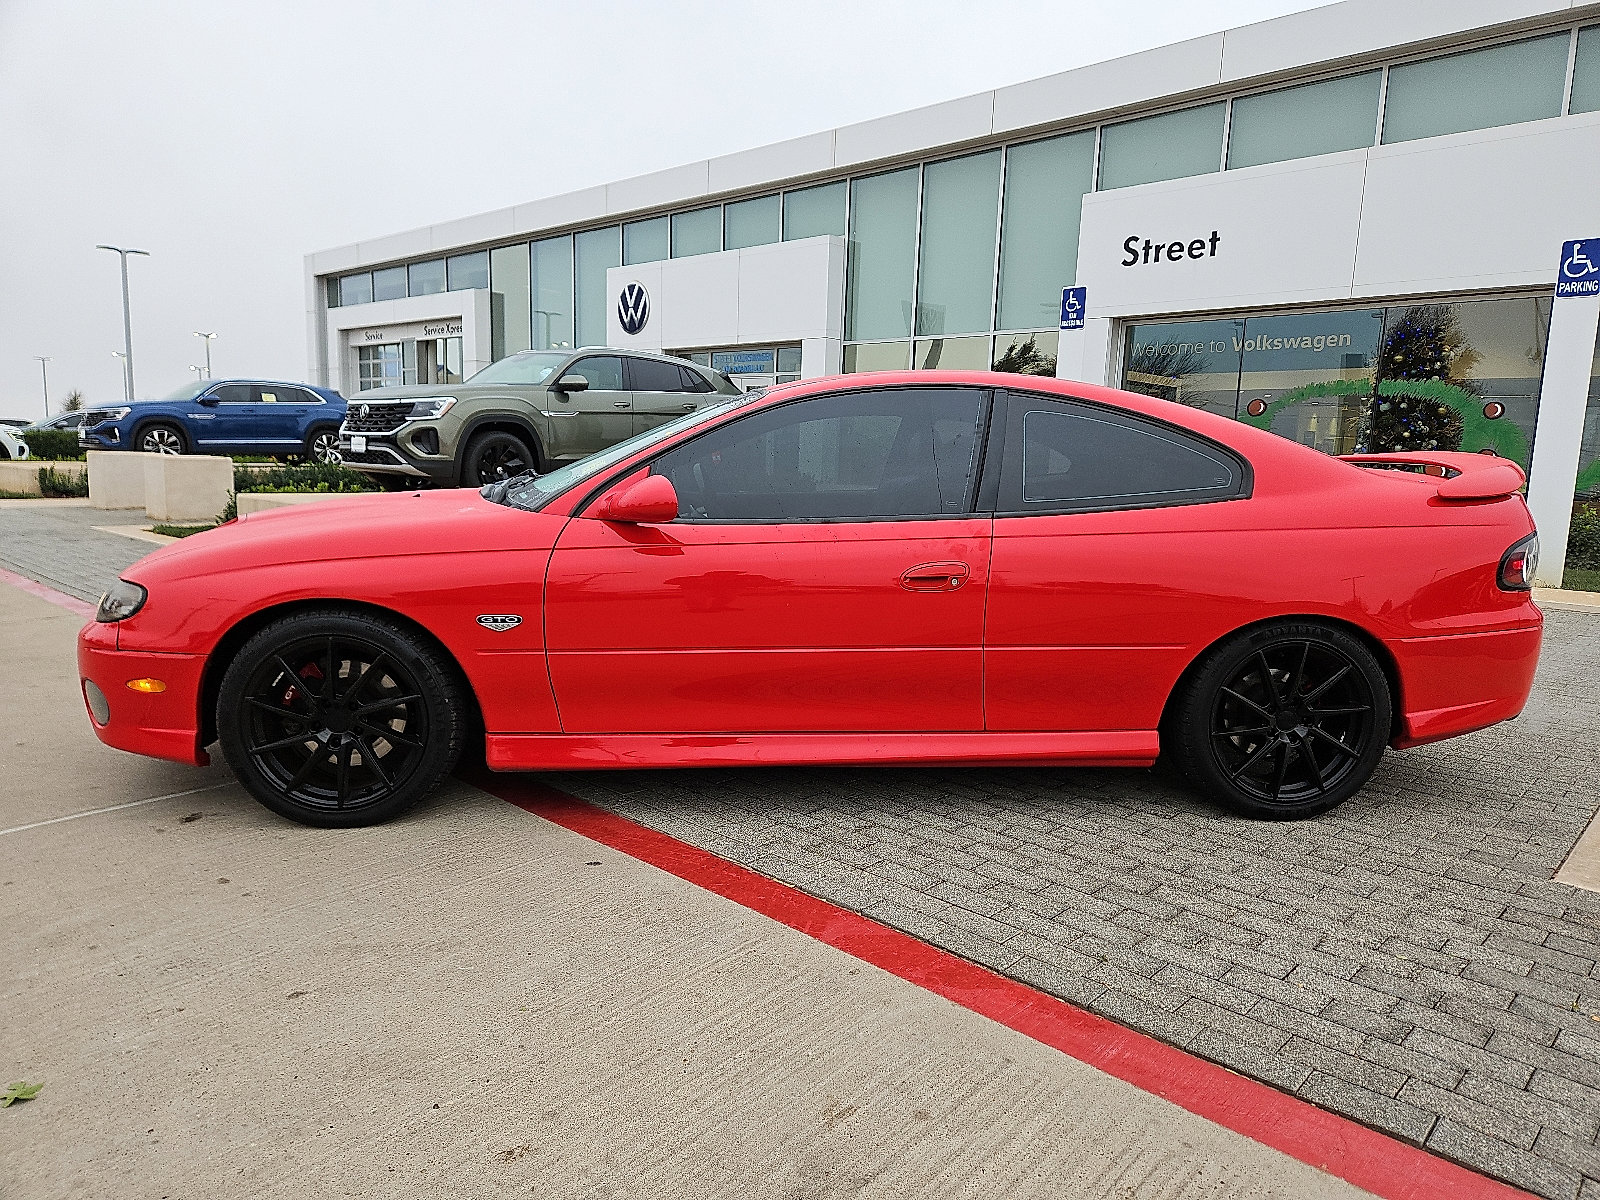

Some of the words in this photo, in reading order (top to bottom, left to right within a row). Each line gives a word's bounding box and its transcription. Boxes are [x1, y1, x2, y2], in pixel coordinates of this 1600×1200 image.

[1121, 230, 1221, 267] Street
[1558, 280, 1599, 294] PARKING
[364, 330, 383, 341] Service
[424, 324, 445, 336] Service
[1130, 340, 1204, 357] Welcome
[1209, 339, 1226, 353] to
[1231, 333, 1351, 352] Volkswagen
